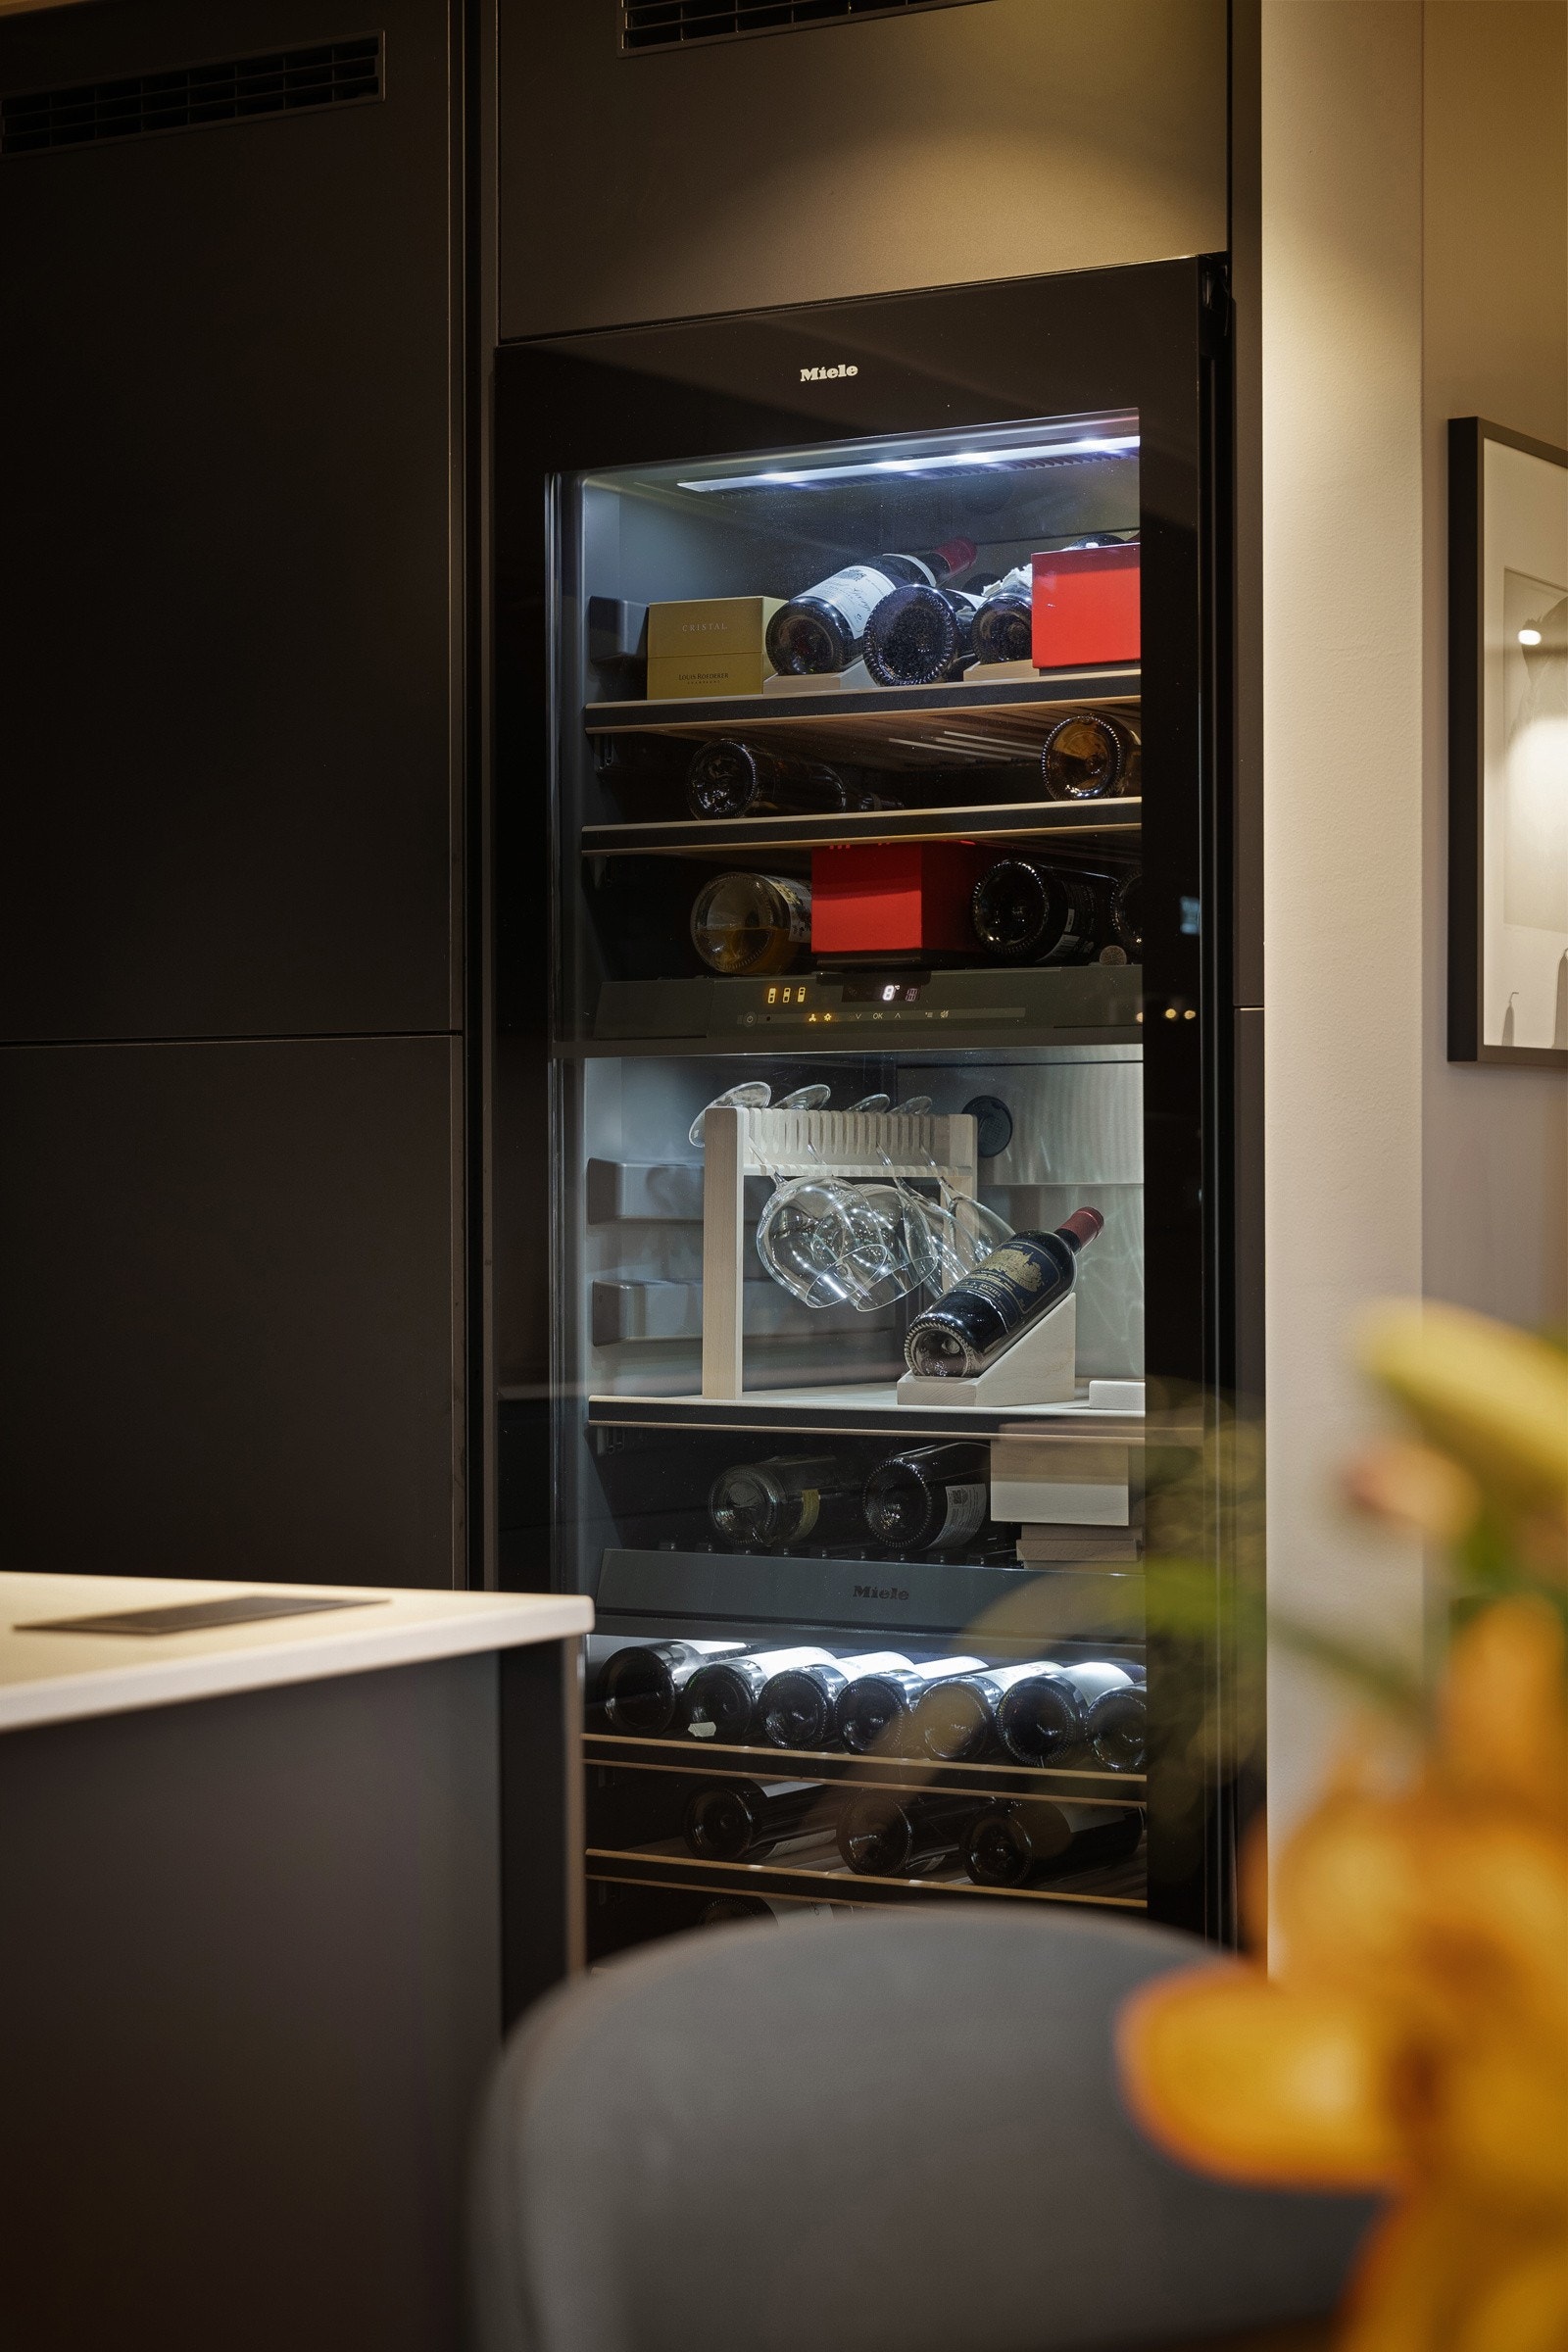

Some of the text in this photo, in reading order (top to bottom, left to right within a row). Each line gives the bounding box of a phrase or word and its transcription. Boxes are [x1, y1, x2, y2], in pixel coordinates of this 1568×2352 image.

[800, 364, 858, 381] Miele
[682, 622, 728, 632] CRISTAL
[853, 1585, 909, 1600] Miele
